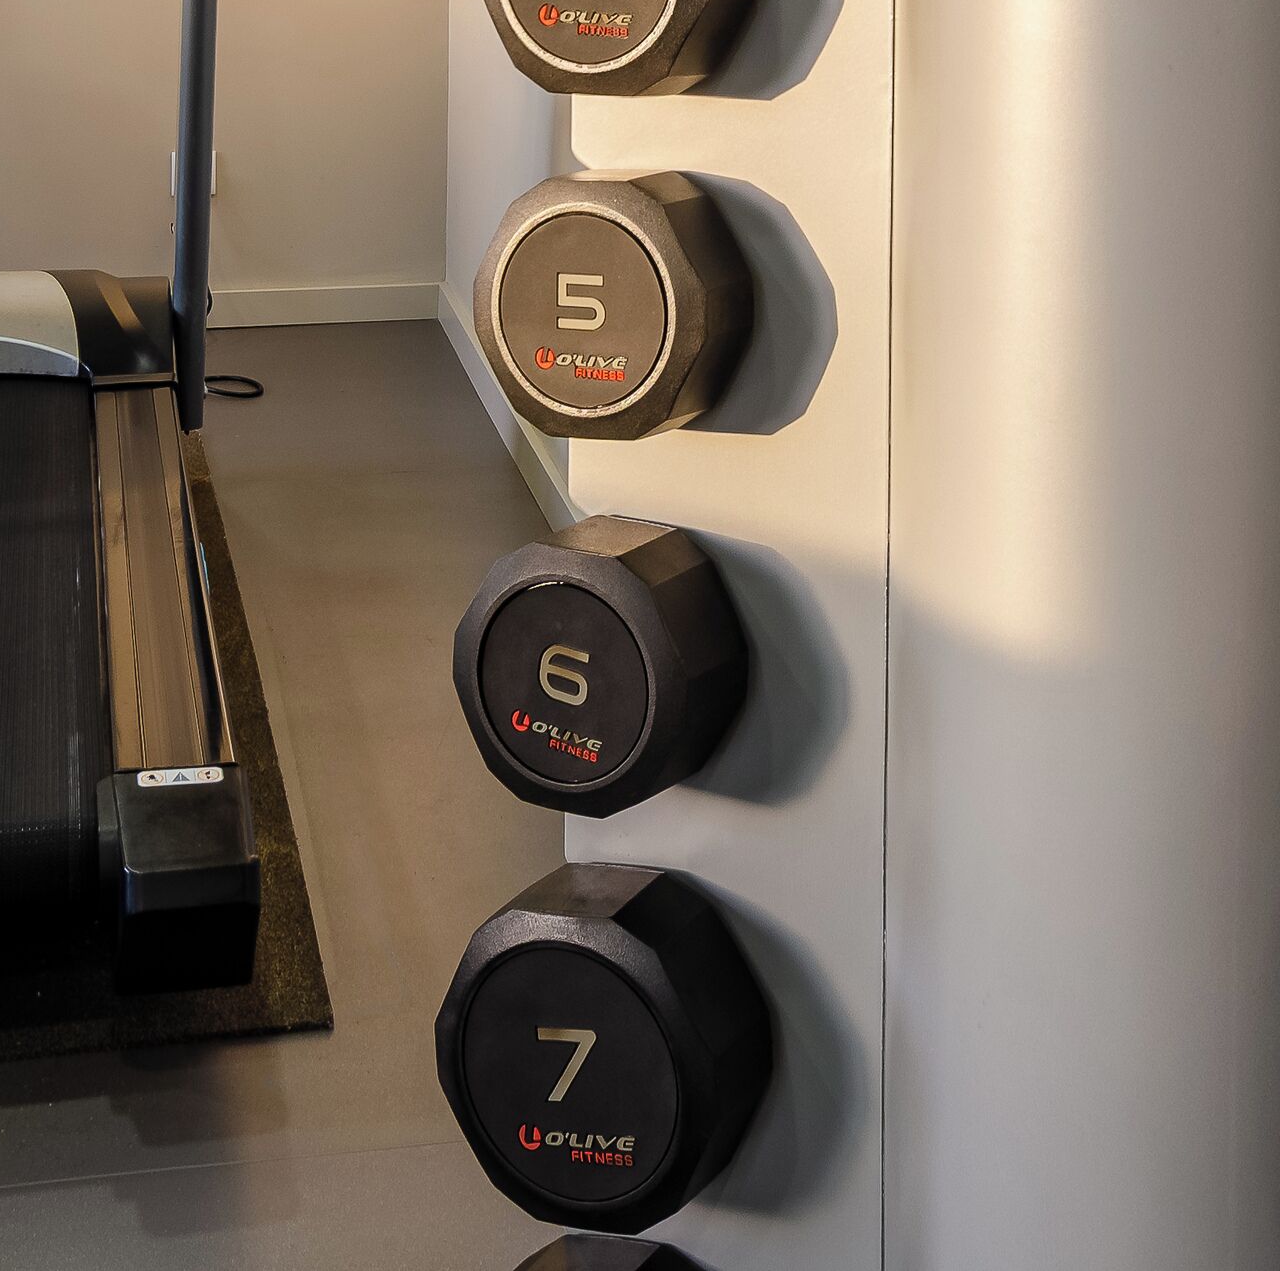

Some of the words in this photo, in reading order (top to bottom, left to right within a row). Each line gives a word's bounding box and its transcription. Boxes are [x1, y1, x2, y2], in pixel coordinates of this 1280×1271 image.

[559, 9, 633, 25] O'LIVE
[557, 272, 606, 330] 5
[556, 353, 628, 369] O'LIVE
[575, 367, 625, 381] FITNESS
[539, 644, 589, 705] 6
[532, 721, 603, 751] O'LIVE
[549, 739, 599, 763] FITNESS
[537, 1027, 597, 1101] 7
[545, 1131, 635, 1151] O'LIVE
[572, 1150, 634, 1166] FITNESS
